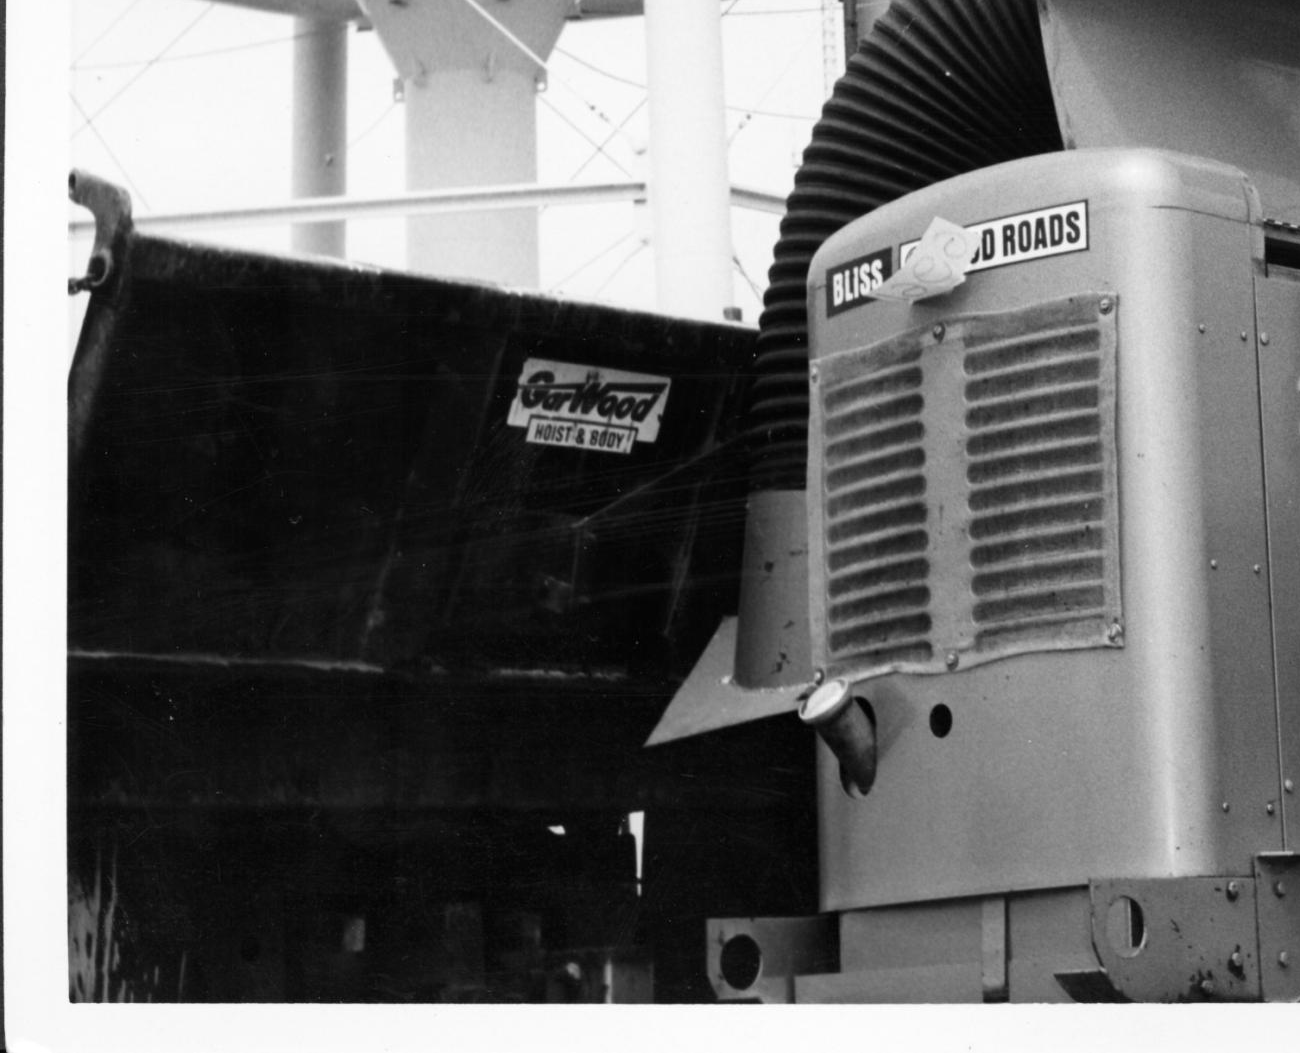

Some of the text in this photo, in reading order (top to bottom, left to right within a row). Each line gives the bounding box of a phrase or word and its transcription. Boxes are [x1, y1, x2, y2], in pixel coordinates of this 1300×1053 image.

[1002, 210, 1081, 258] ROADS
[833, 258, 883, 306] BLISS
[534, 423, 625, 449] HOIST & BODY
